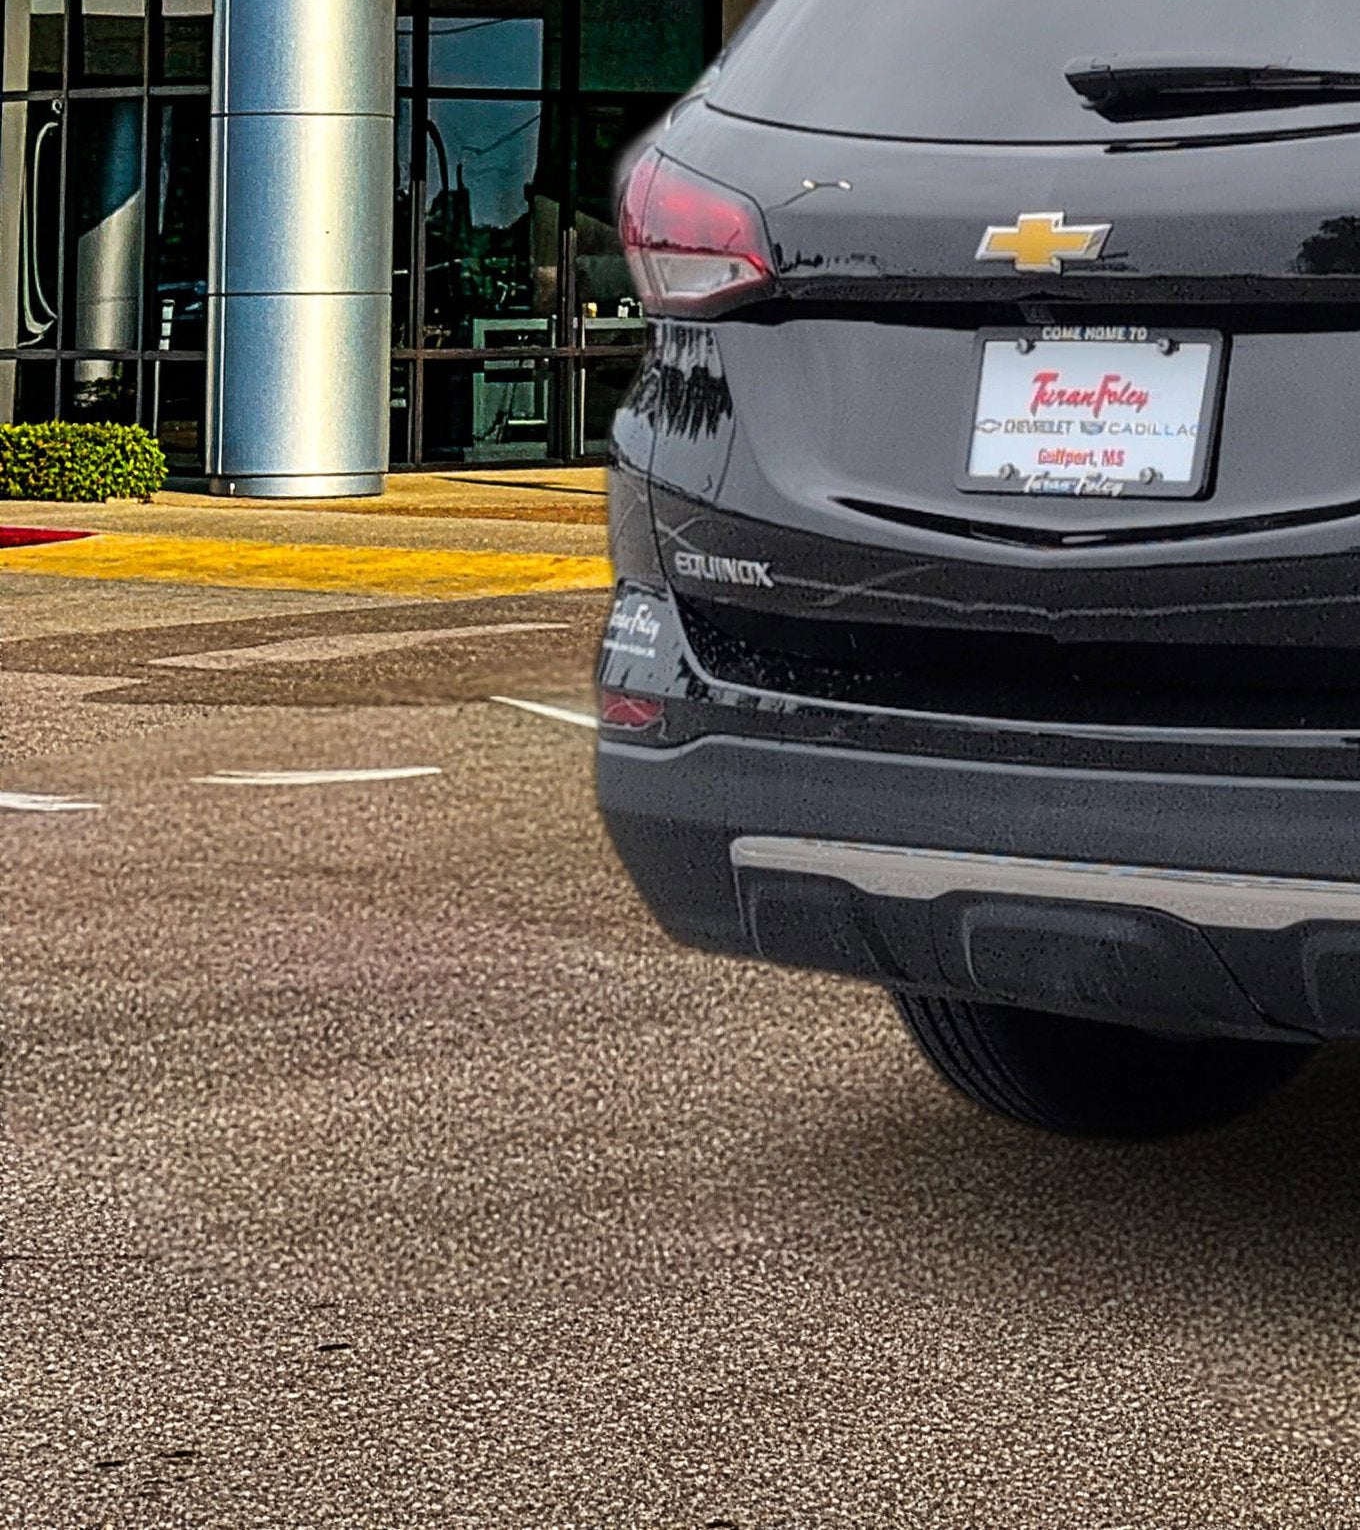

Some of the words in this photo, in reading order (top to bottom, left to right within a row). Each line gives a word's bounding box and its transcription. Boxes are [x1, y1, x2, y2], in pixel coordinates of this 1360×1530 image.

[1042, 326, 1082, 340] COME
[1085, 326, 1126, 341] HOME
[1129, 327, 1148, 341] TO
[1102, 450, 1125, 467] MS
[674, 551, 775, 588] EQUINOX
